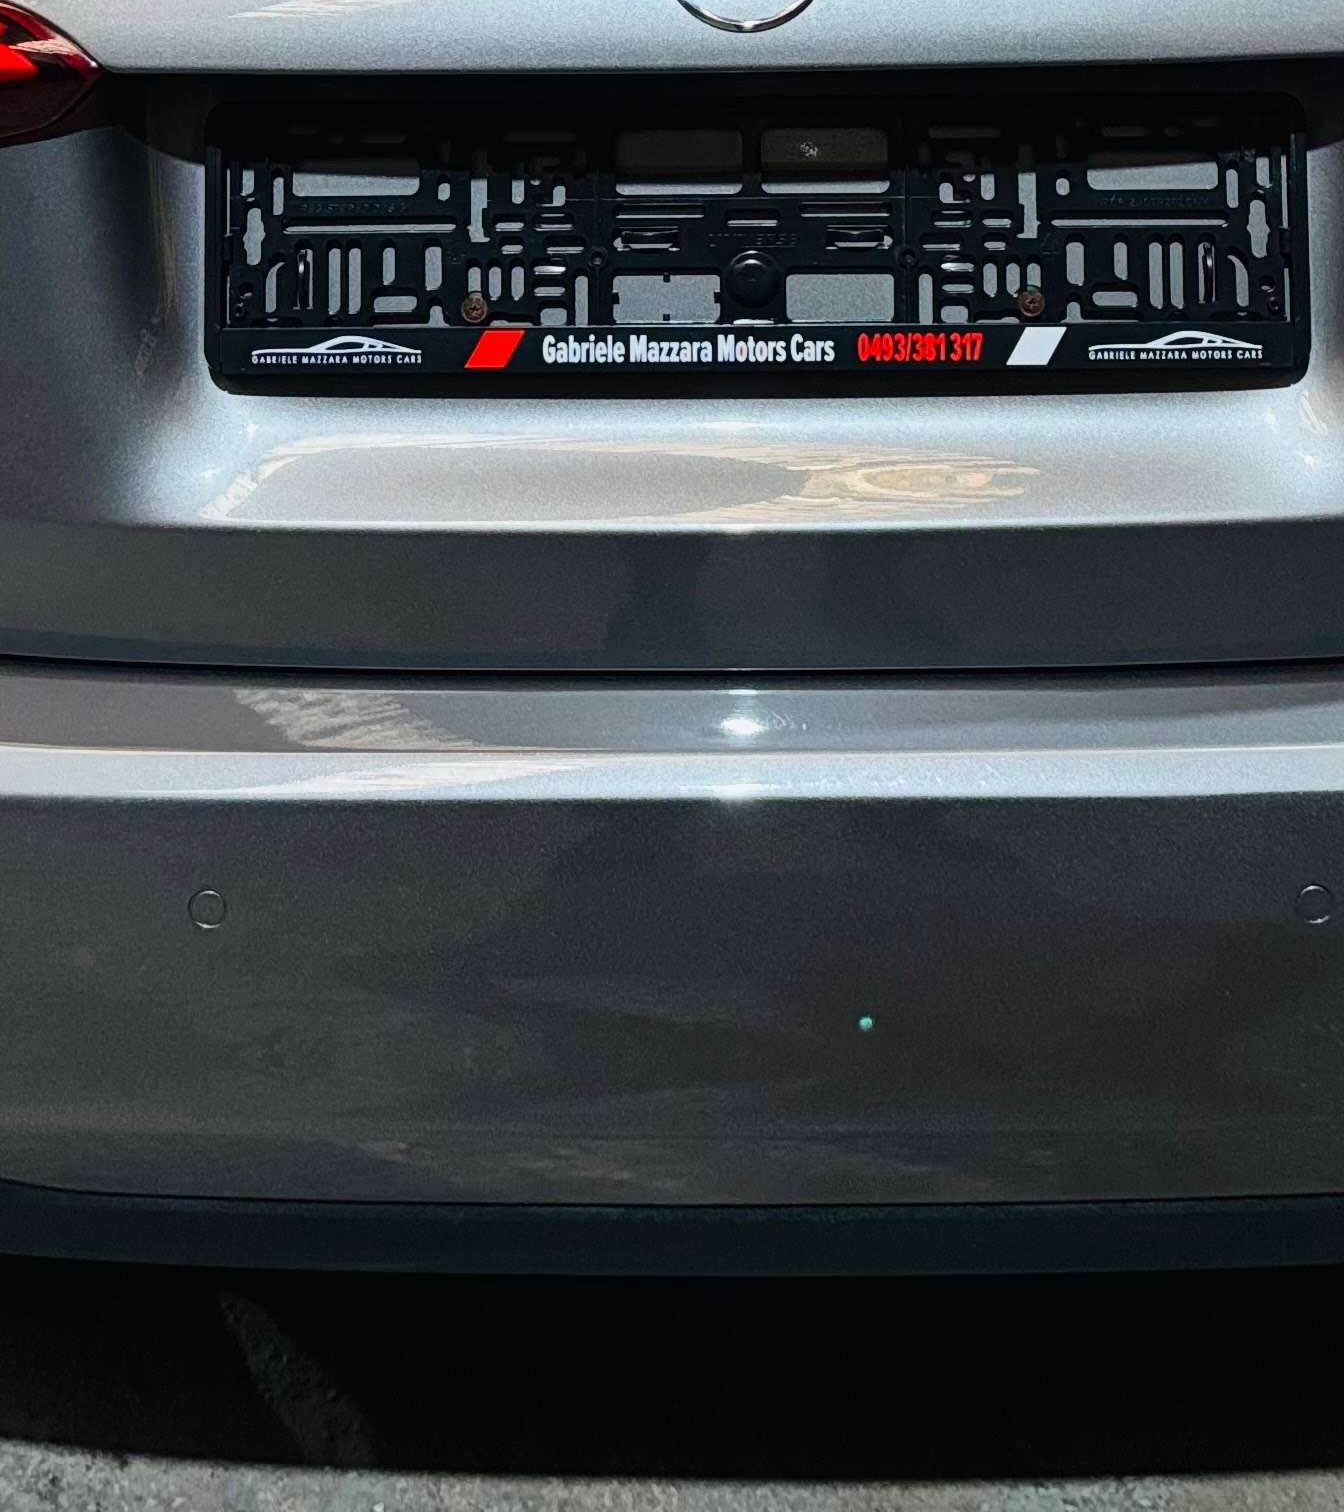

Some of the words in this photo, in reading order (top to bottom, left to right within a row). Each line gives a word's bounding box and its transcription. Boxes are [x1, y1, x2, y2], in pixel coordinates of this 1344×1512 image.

[542, 334, 626, 364] Gabriele
[630, 335, 713, 363] Mazzara
[717, 334, 787, 363] Motors
[790, 334, 836, 363] Cars
[857, 332, 946, 363] 0493/381
[950, 332, 984, 362] 317
[251, 354, 299, 365] GABRIELE
[302, 354, 348, 364] MAZZARA
[352, 354, 392, 364] MOTORS
[396, 354, 423, 364] CARS
[1088, 350, 1136, 361] GABRIELE
[1140, 350, 1188, 360] MAZZARA
[1191, 350, 1234, 360] MOTORS
[1236, 349, 1264, 359] CARS
